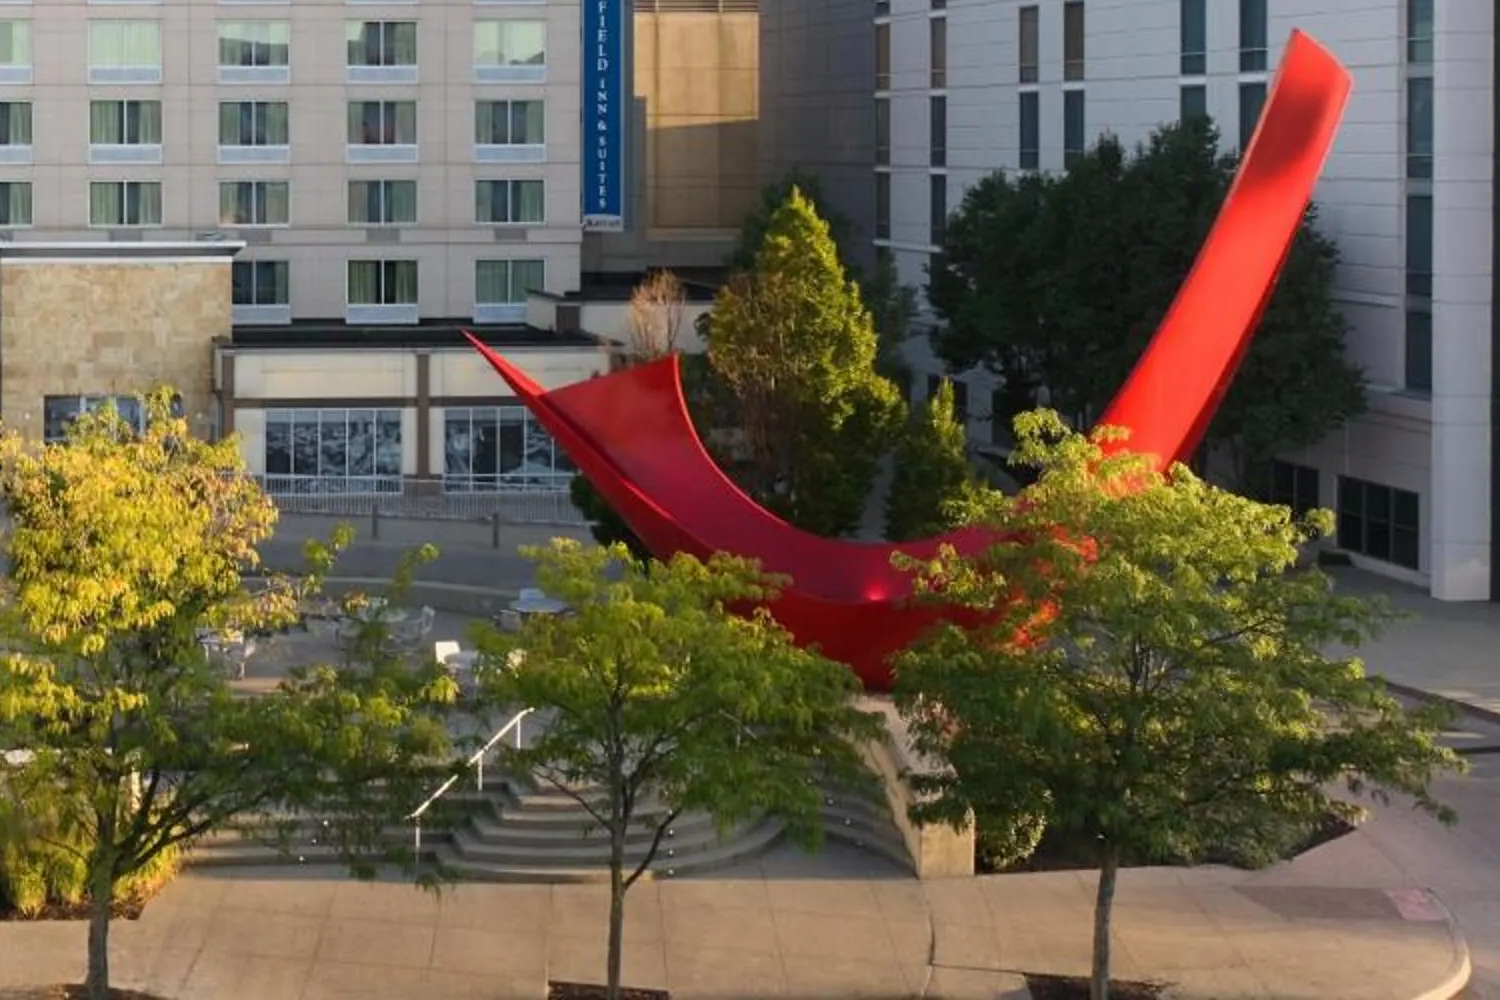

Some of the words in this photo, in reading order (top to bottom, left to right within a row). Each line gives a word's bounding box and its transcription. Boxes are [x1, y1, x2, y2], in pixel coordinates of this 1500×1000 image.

[597, 78, 607, 114] INN
[597, 119, 607, 131] &
[597, 136, 607, 208] SUITES
